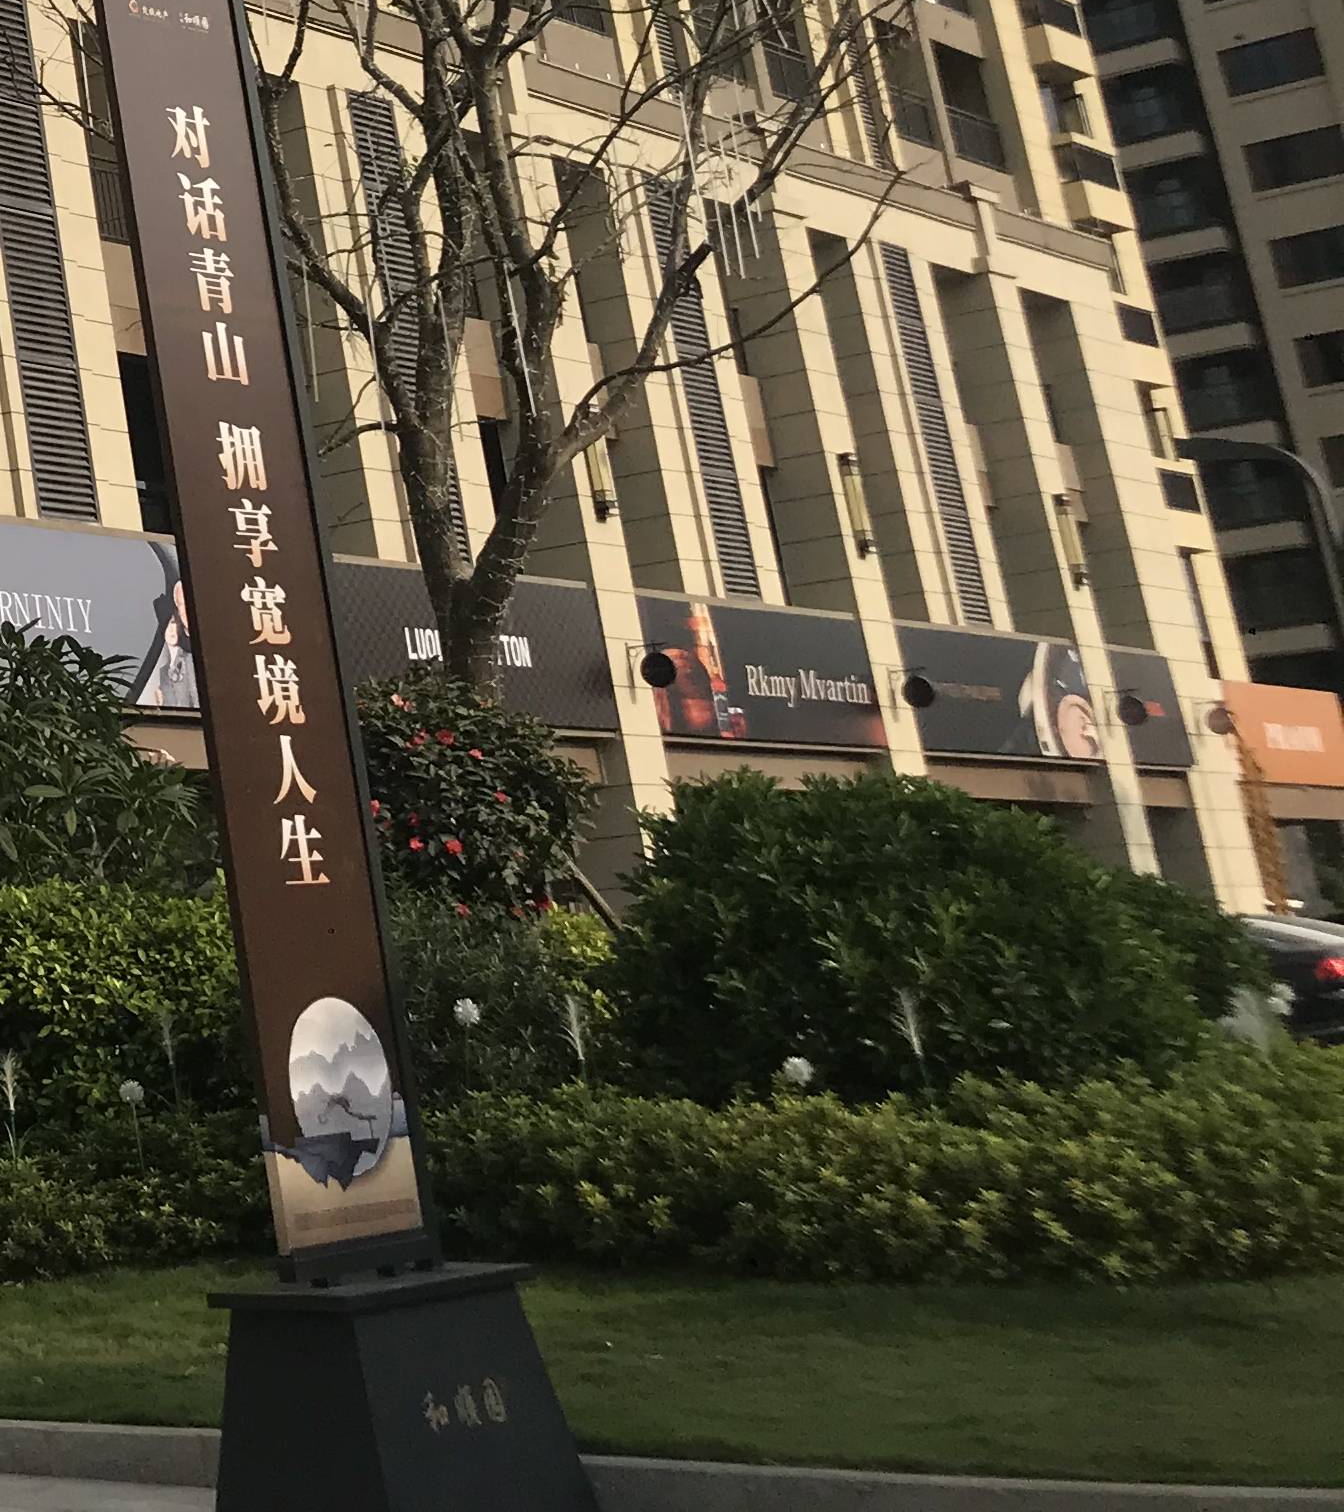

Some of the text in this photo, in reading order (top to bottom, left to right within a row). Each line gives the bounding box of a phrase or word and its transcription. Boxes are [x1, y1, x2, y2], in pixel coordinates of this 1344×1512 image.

[165, 105, 330, 885] 对话青山 拥享宽境人生
[745, 664, 872, 708] Rkmy Mvartin
